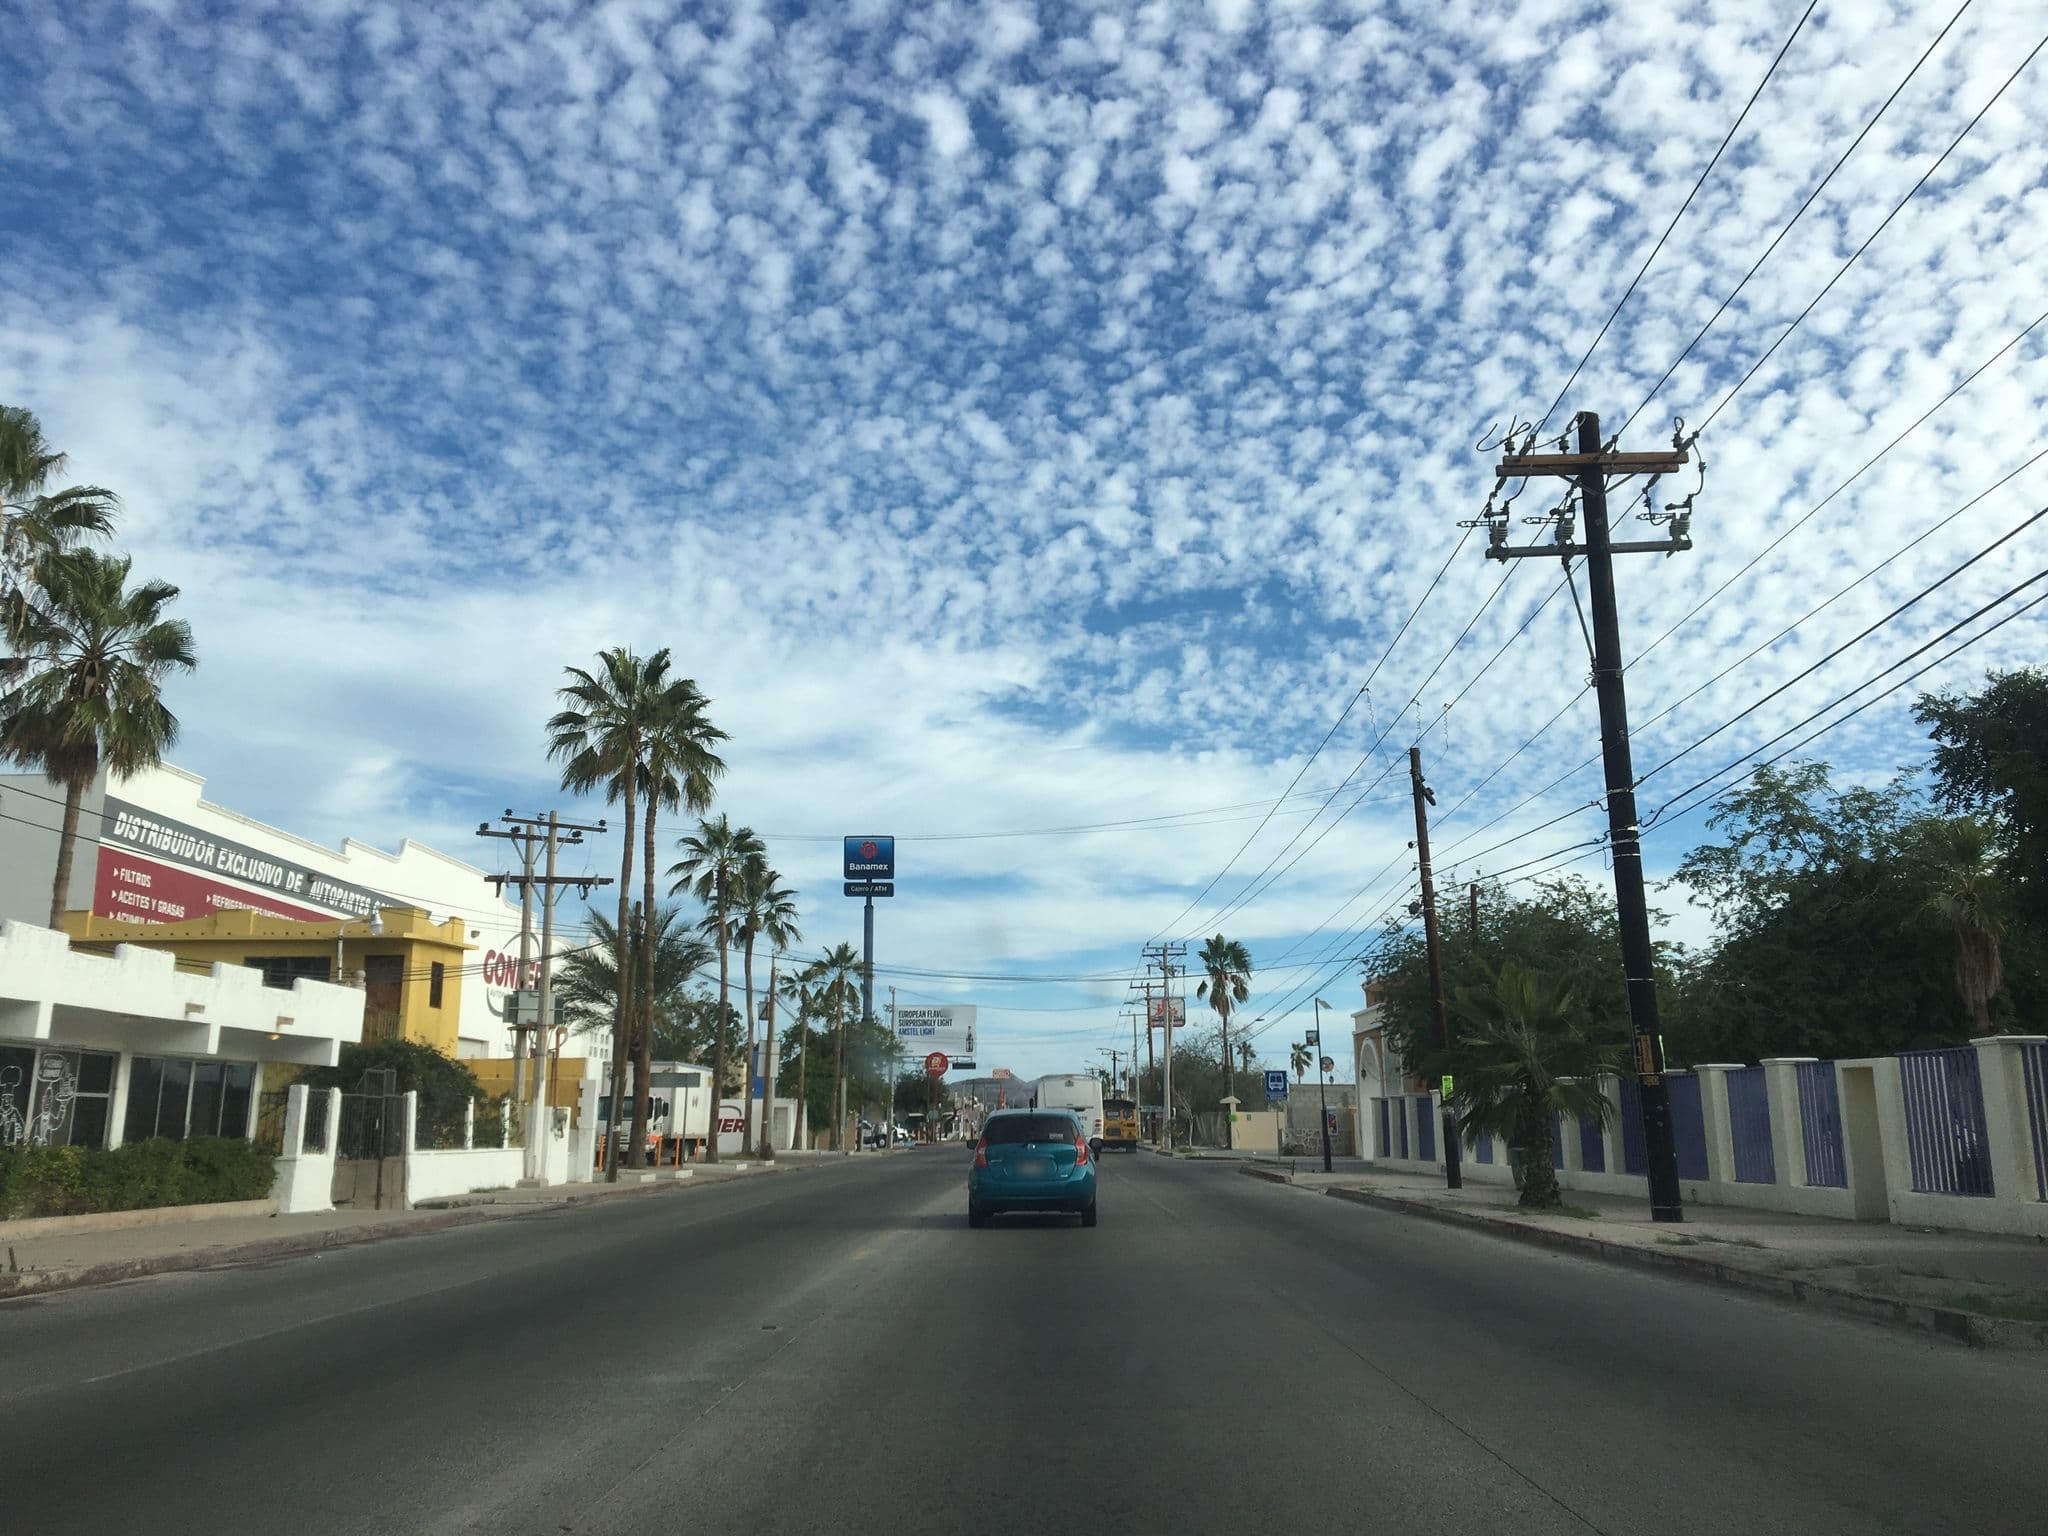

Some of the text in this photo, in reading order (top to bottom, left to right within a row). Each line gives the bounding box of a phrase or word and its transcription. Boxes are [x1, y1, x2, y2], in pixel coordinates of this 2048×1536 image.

[113, 812, 371, 916] DISTRIBUIDOR EXCLUSIVO DE AUTOPARTES
[119, 868, 151, 887] FILTROS
[118, 890, 185, 918] ACEITES Y GRASAS
[898, 1010, 926, 1018] EUROPEAN
[898, 1018, 953, 1027] SURPRISINGLY LIGHT
[898, 1027, 935, 1035] AMSTEL LIGHT
